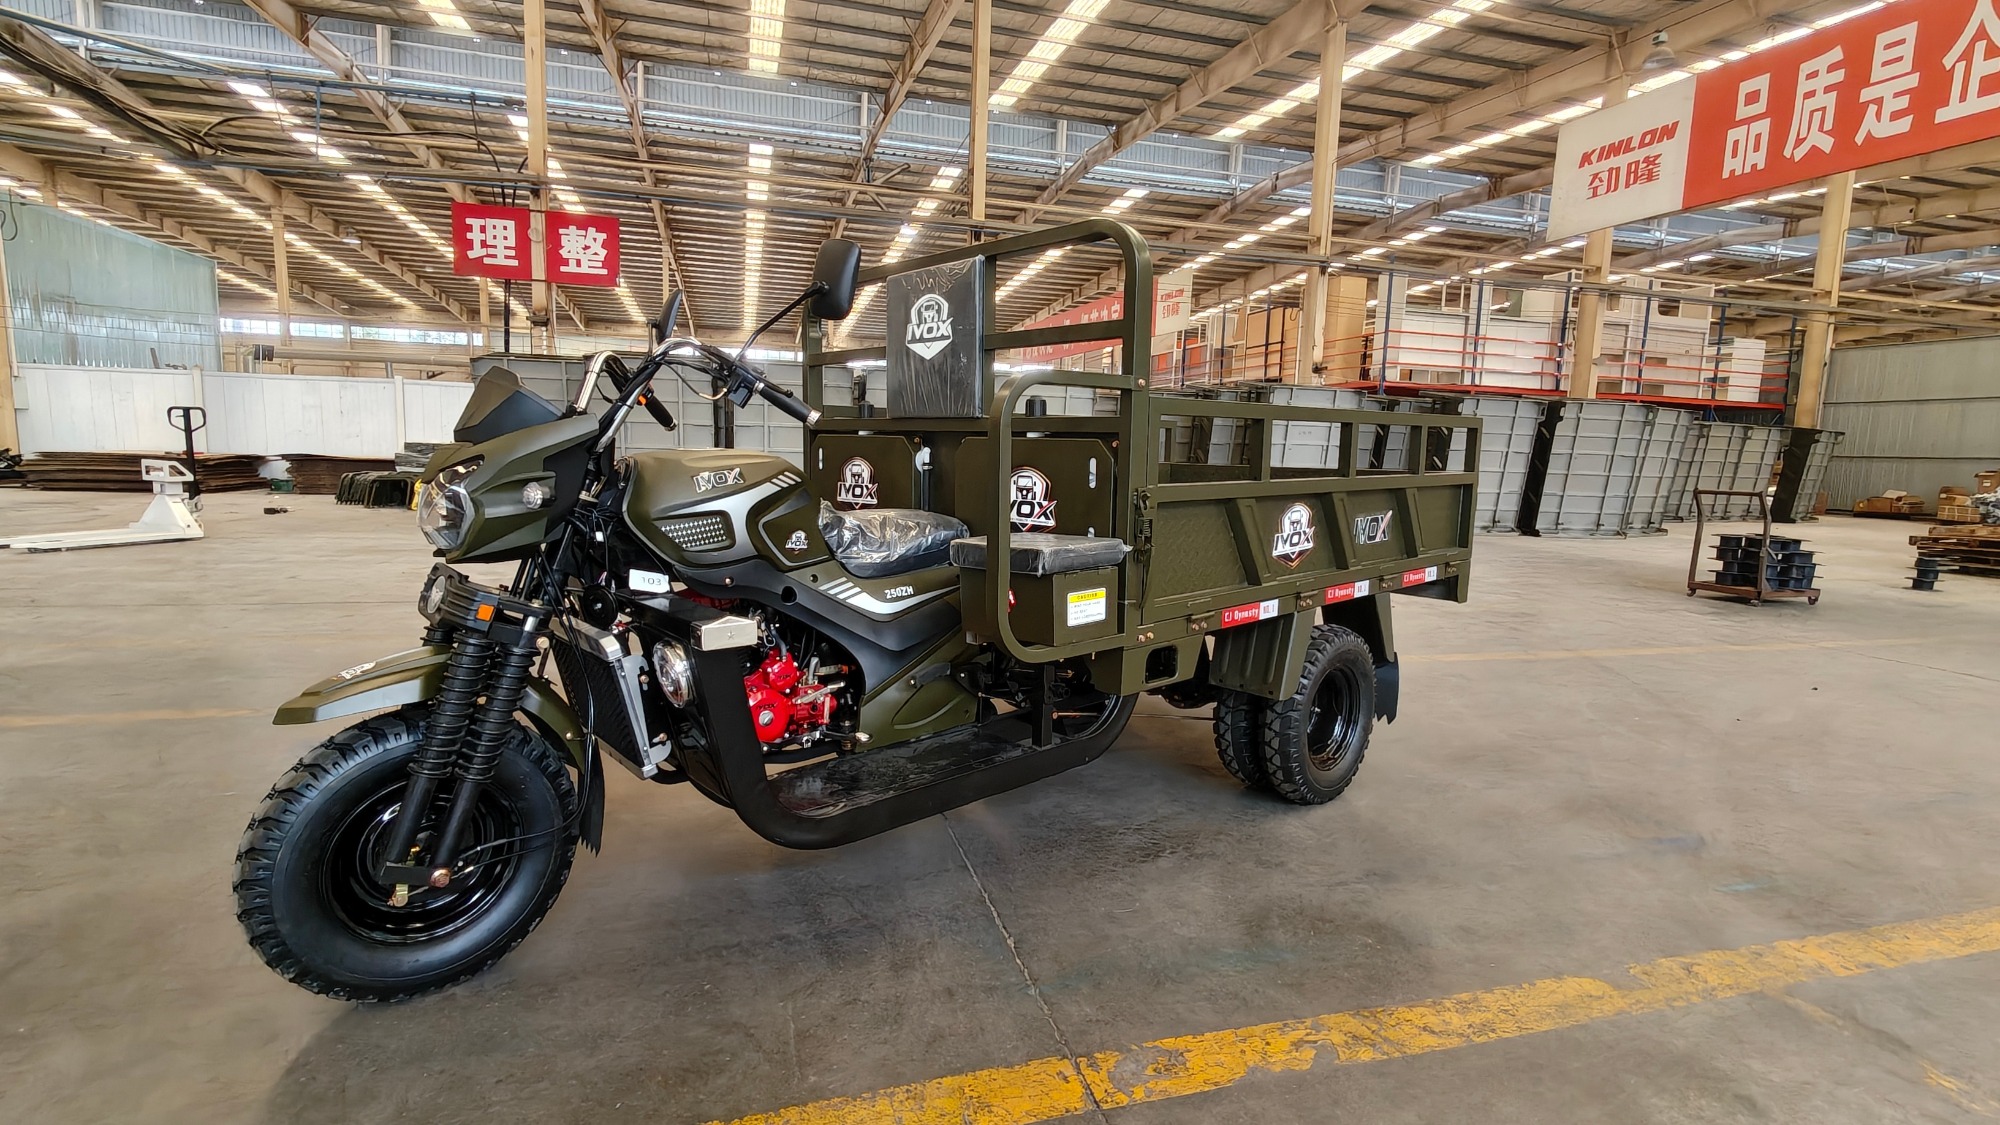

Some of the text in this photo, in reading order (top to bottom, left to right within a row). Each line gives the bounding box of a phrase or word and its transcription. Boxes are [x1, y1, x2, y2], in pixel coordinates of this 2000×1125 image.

[1721, 0, 2000, 179] 品质是企
[1578, 120, 1680, 169] KINLON
[1586, 153, 1663, 200] 劲隆
[907, 317, 954, 341] IVOX
[693, 467, 744, 493] IVOX
[838, 483, 878, 499] IVOX
[1274, 526, 1315, 551] IVOX
[1353, 510, 1393, 545] IVOX
[786, 540, 809, 548] IVOX
[641, 576, 662, 586] 103
[884, 586, 914, 599] 250ZH
[1335, 587, 1354, 598] Dynasty
[1224, 611, 1233, 622] CJ
[1234, 608, 1259, 621] Dynasty
